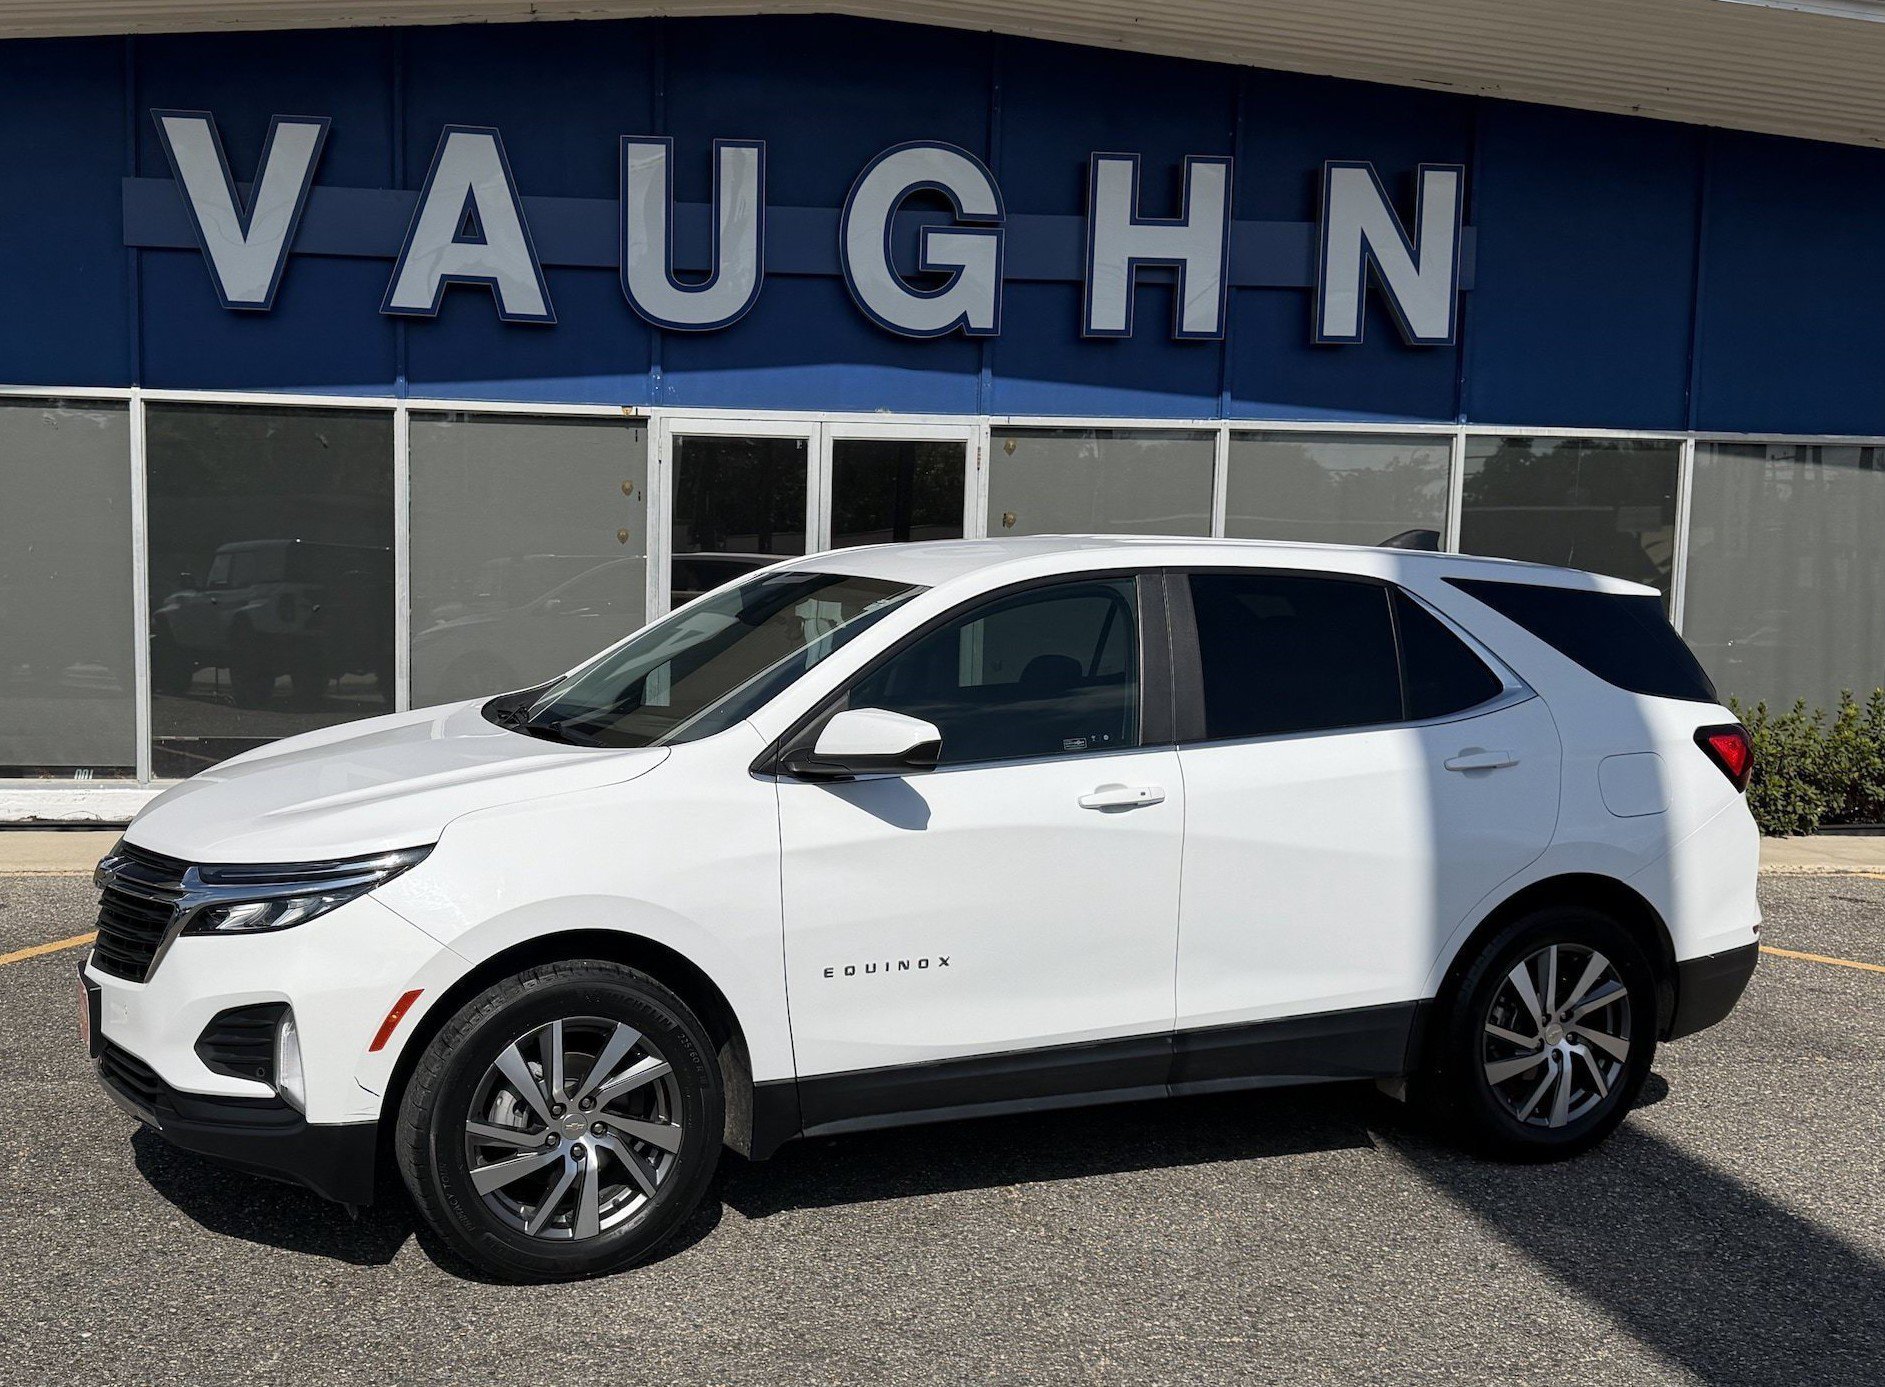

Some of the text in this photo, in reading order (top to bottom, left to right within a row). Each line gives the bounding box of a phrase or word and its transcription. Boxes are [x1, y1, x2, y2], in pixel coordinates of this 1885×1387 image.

[150, 108, 1465, 346] VAUGHN
[823, 955, 951, 978] EQUINOX
[446, 1193, 477, 1232] PRIMACY
